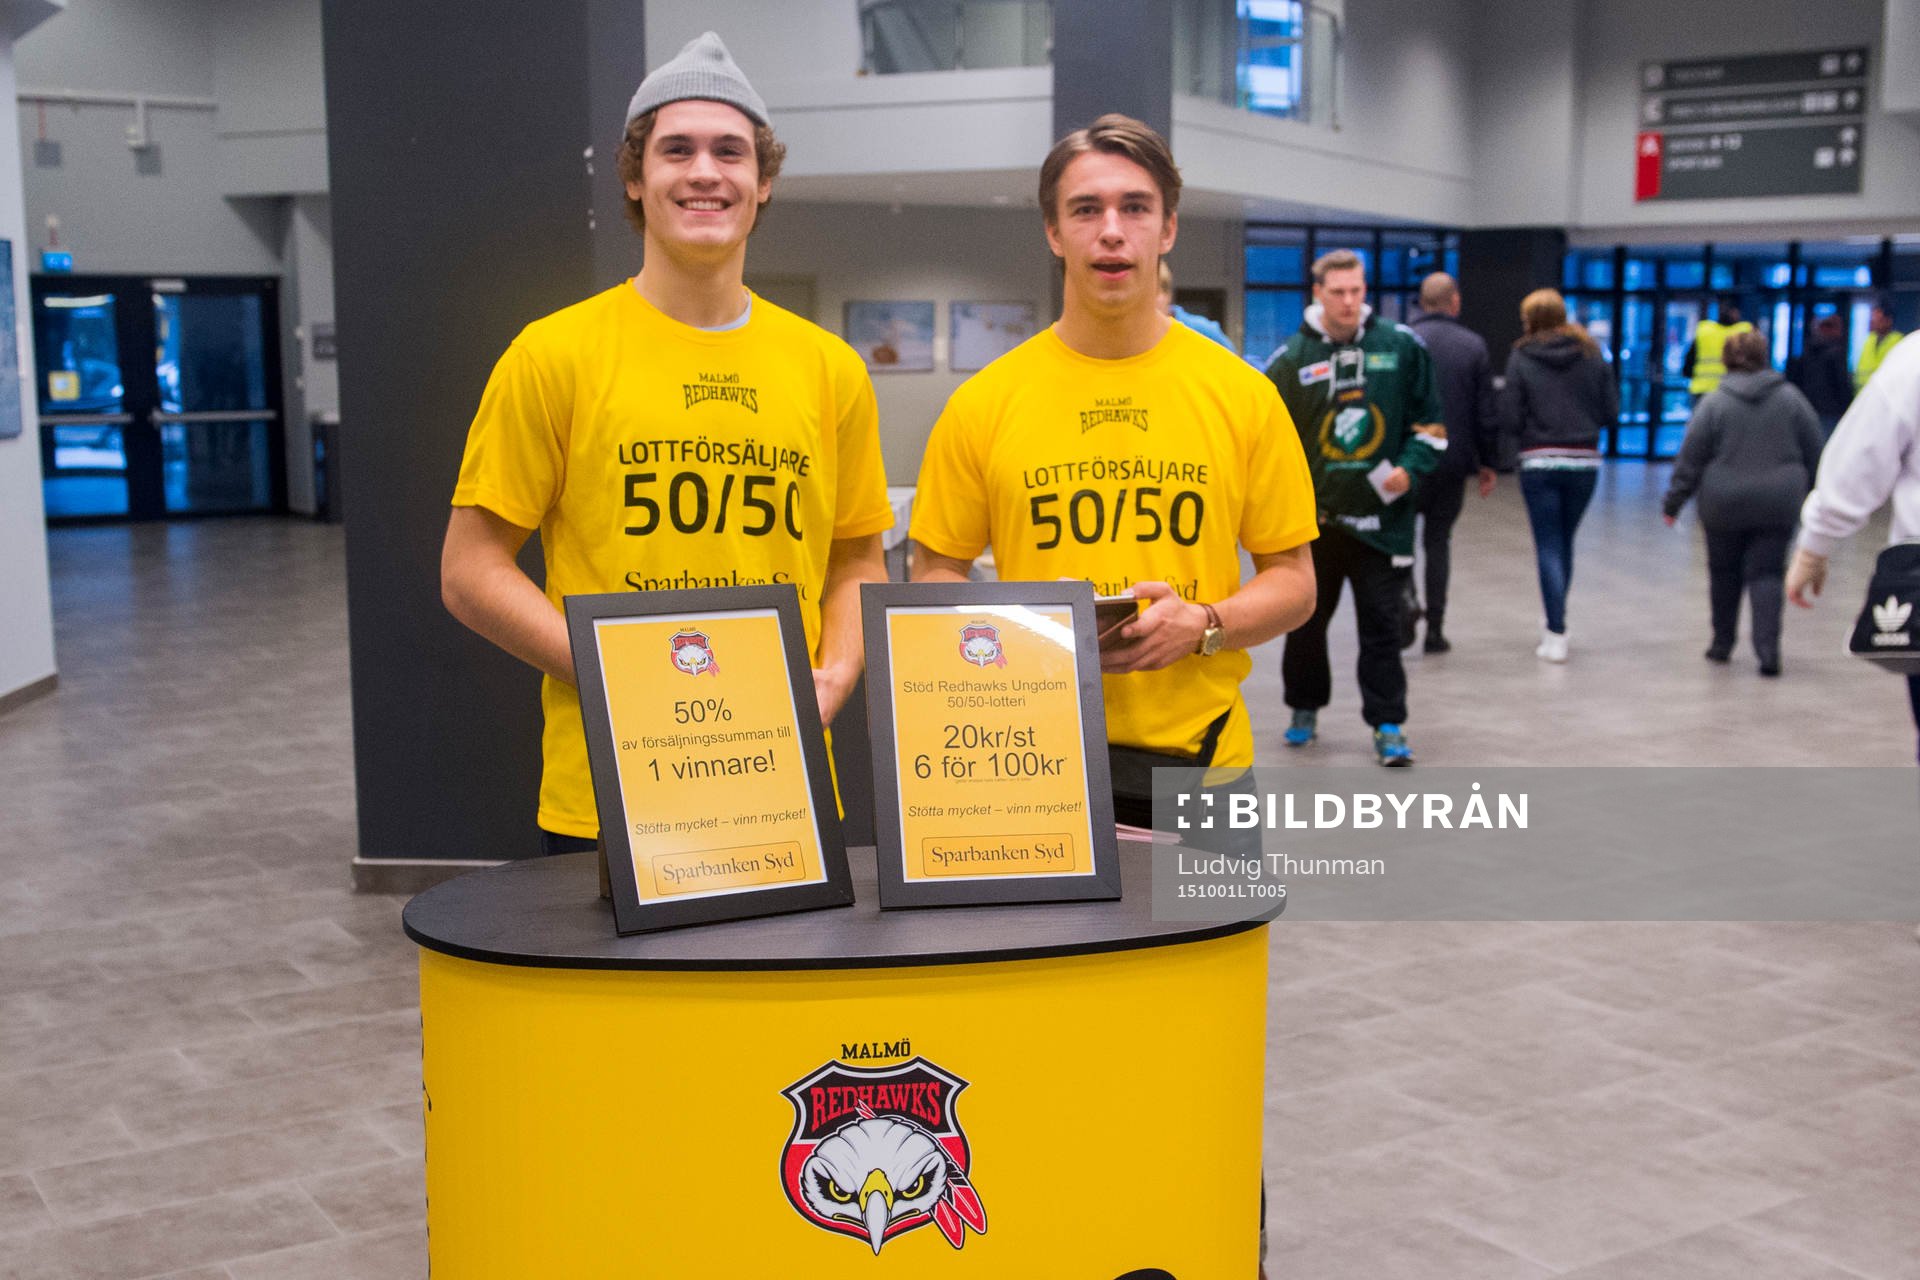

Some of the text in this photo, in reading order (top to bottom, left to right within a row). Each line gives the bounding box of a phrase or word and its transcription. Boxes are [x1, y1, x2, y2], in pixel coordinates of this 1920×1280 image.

[699, 373, 740, 384] MALMÖ
[683, 384, 759, 414] REDHAWKS
[1080, 409, 1149, 434] REDHAWKS
[618, 435, 811, 477] LOTTFÖRSÄLJARE
[1024, 455, 1209, 489] LOTTFÖRSÄLJARE
[624, 471, 804, 542] 50/50
[1030, 487, 1205, 550] 50/50
[903, 679, 1067, 694] Stöd Redhawks Ungdom
[674, 698, 732, 724] 50%
[947, 696, 1027, 709] 50/50-lotteri
[622, 726, 791, 751] av försäljningssumman till
[943, 724, 1037, 749] 20kr/st
[648, 749, 776, 782] 1 vinnare!
[914, 754, 932, 779] 6
[941, 755, 976, 778] för
[635, 822, 671, 835] Stötta
[675, 817, 718, 833] mycket
[733, 813, 758, 826] vinn
[761, 808, 807, 824] mycket!
[908, 805, 944, 817] Stötta
[948, 804, 992, 818] mycket
[1006, 803, 1032, 815] vinn
[1036, 801, 1082, 815] mycket!
[931, 843, 1065, 867] Sparbanken Syd
[663, 852, 794, 885] Sparbanken Syd
[841, 1038, 911, 1060] MALMÖ
[810, 1081, 941, 1133] REDHAWKS
